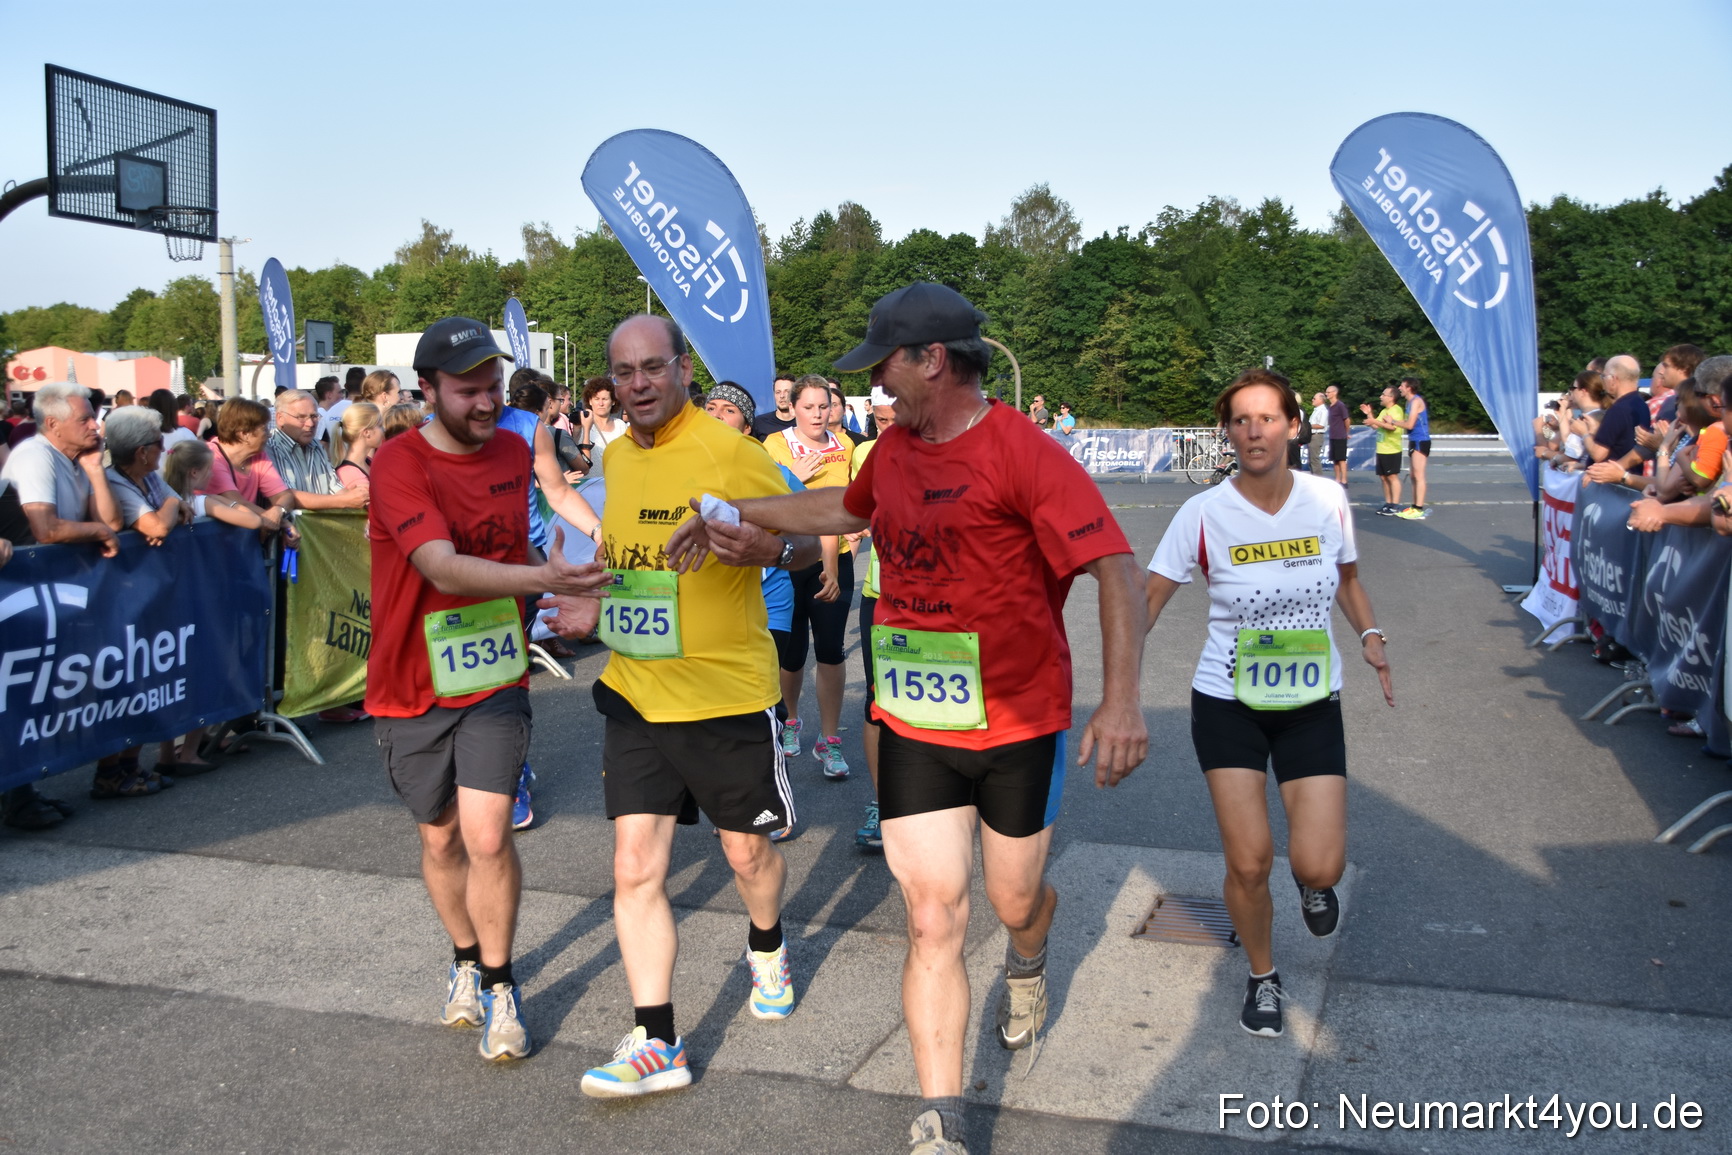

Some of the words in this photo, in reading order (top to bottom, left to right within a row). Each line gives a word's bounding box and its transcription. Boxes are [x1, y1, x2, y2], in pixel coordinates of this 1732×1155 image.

[824, 453, 847, 464] BÖGL
[1083, 447, 1146, 460] Fischer
[489, 480, 515, 495] swn
[923, 488, 953, 500] swn
[639, 508, 670, 520] swn
[1234, 539, 1314, 562] ONLINE
[1283, 558, 1323, 569] Germany
[1583, 538, 1624, 594] Fischer
[911, 597, 954, 615] läuft
[605, 604, 670, 636] 1525
[440, 632, 518, 673] 1534
[886, 643, 922, 655] firmenlauf
[0, 624, 196, 714] Fischer
[1246, 661, 1320, 688] 1010
[884, 667, 970, 704] 1533
[20, 677, 187, 746] AUTOMOBILE
